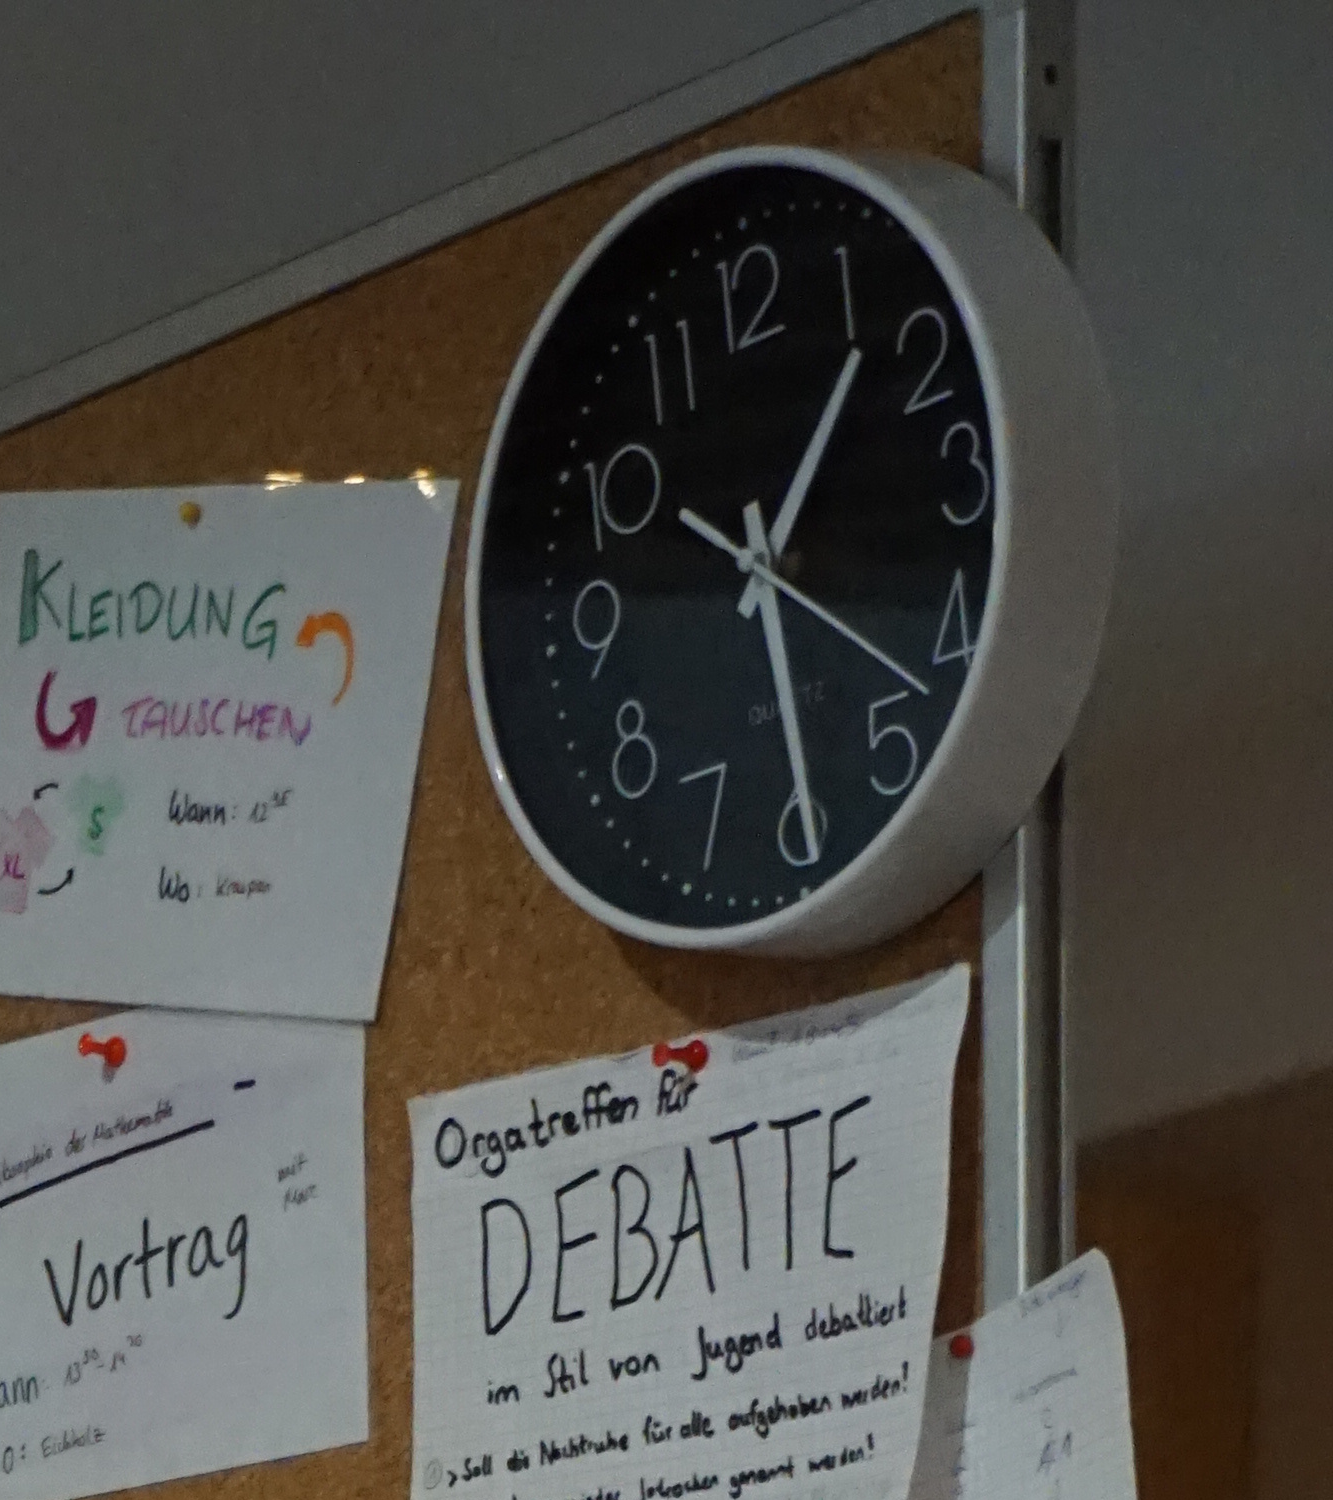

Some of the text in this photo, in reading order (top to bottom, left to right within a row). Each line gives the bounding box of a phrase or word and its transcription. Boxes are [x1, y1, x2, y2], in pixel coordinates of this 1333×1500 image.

[718, 244, 787, 355] 12
[835, 246, 856, 340] 1
[645, 319, 697, 426] 11
[896, 308, 954, 415] 2
[585, 442, 662, 552] 10
[941, 421, 991, 526] 3
[17, 549, 286, 661] KLEIDUNG
[572, 579, 621, 681] 9
[933, 568, 978, 667] 4
[120, 696, 312, 748] TAUSCHEN
[612, 699, 658, 798] 8
[867, 691, 919, 796] 5
[3, 854, 25, 879] XL
[678, 762, 728, 872] 7
[434, 1069, 698, 1178] Orgatreffen für
[481, 1096, 871, 1336] DEBATTE
[44, 1213, 249, 1327] Vortrag
[487, 1286, 906, 1405] im Stil von Jugend debattiert
